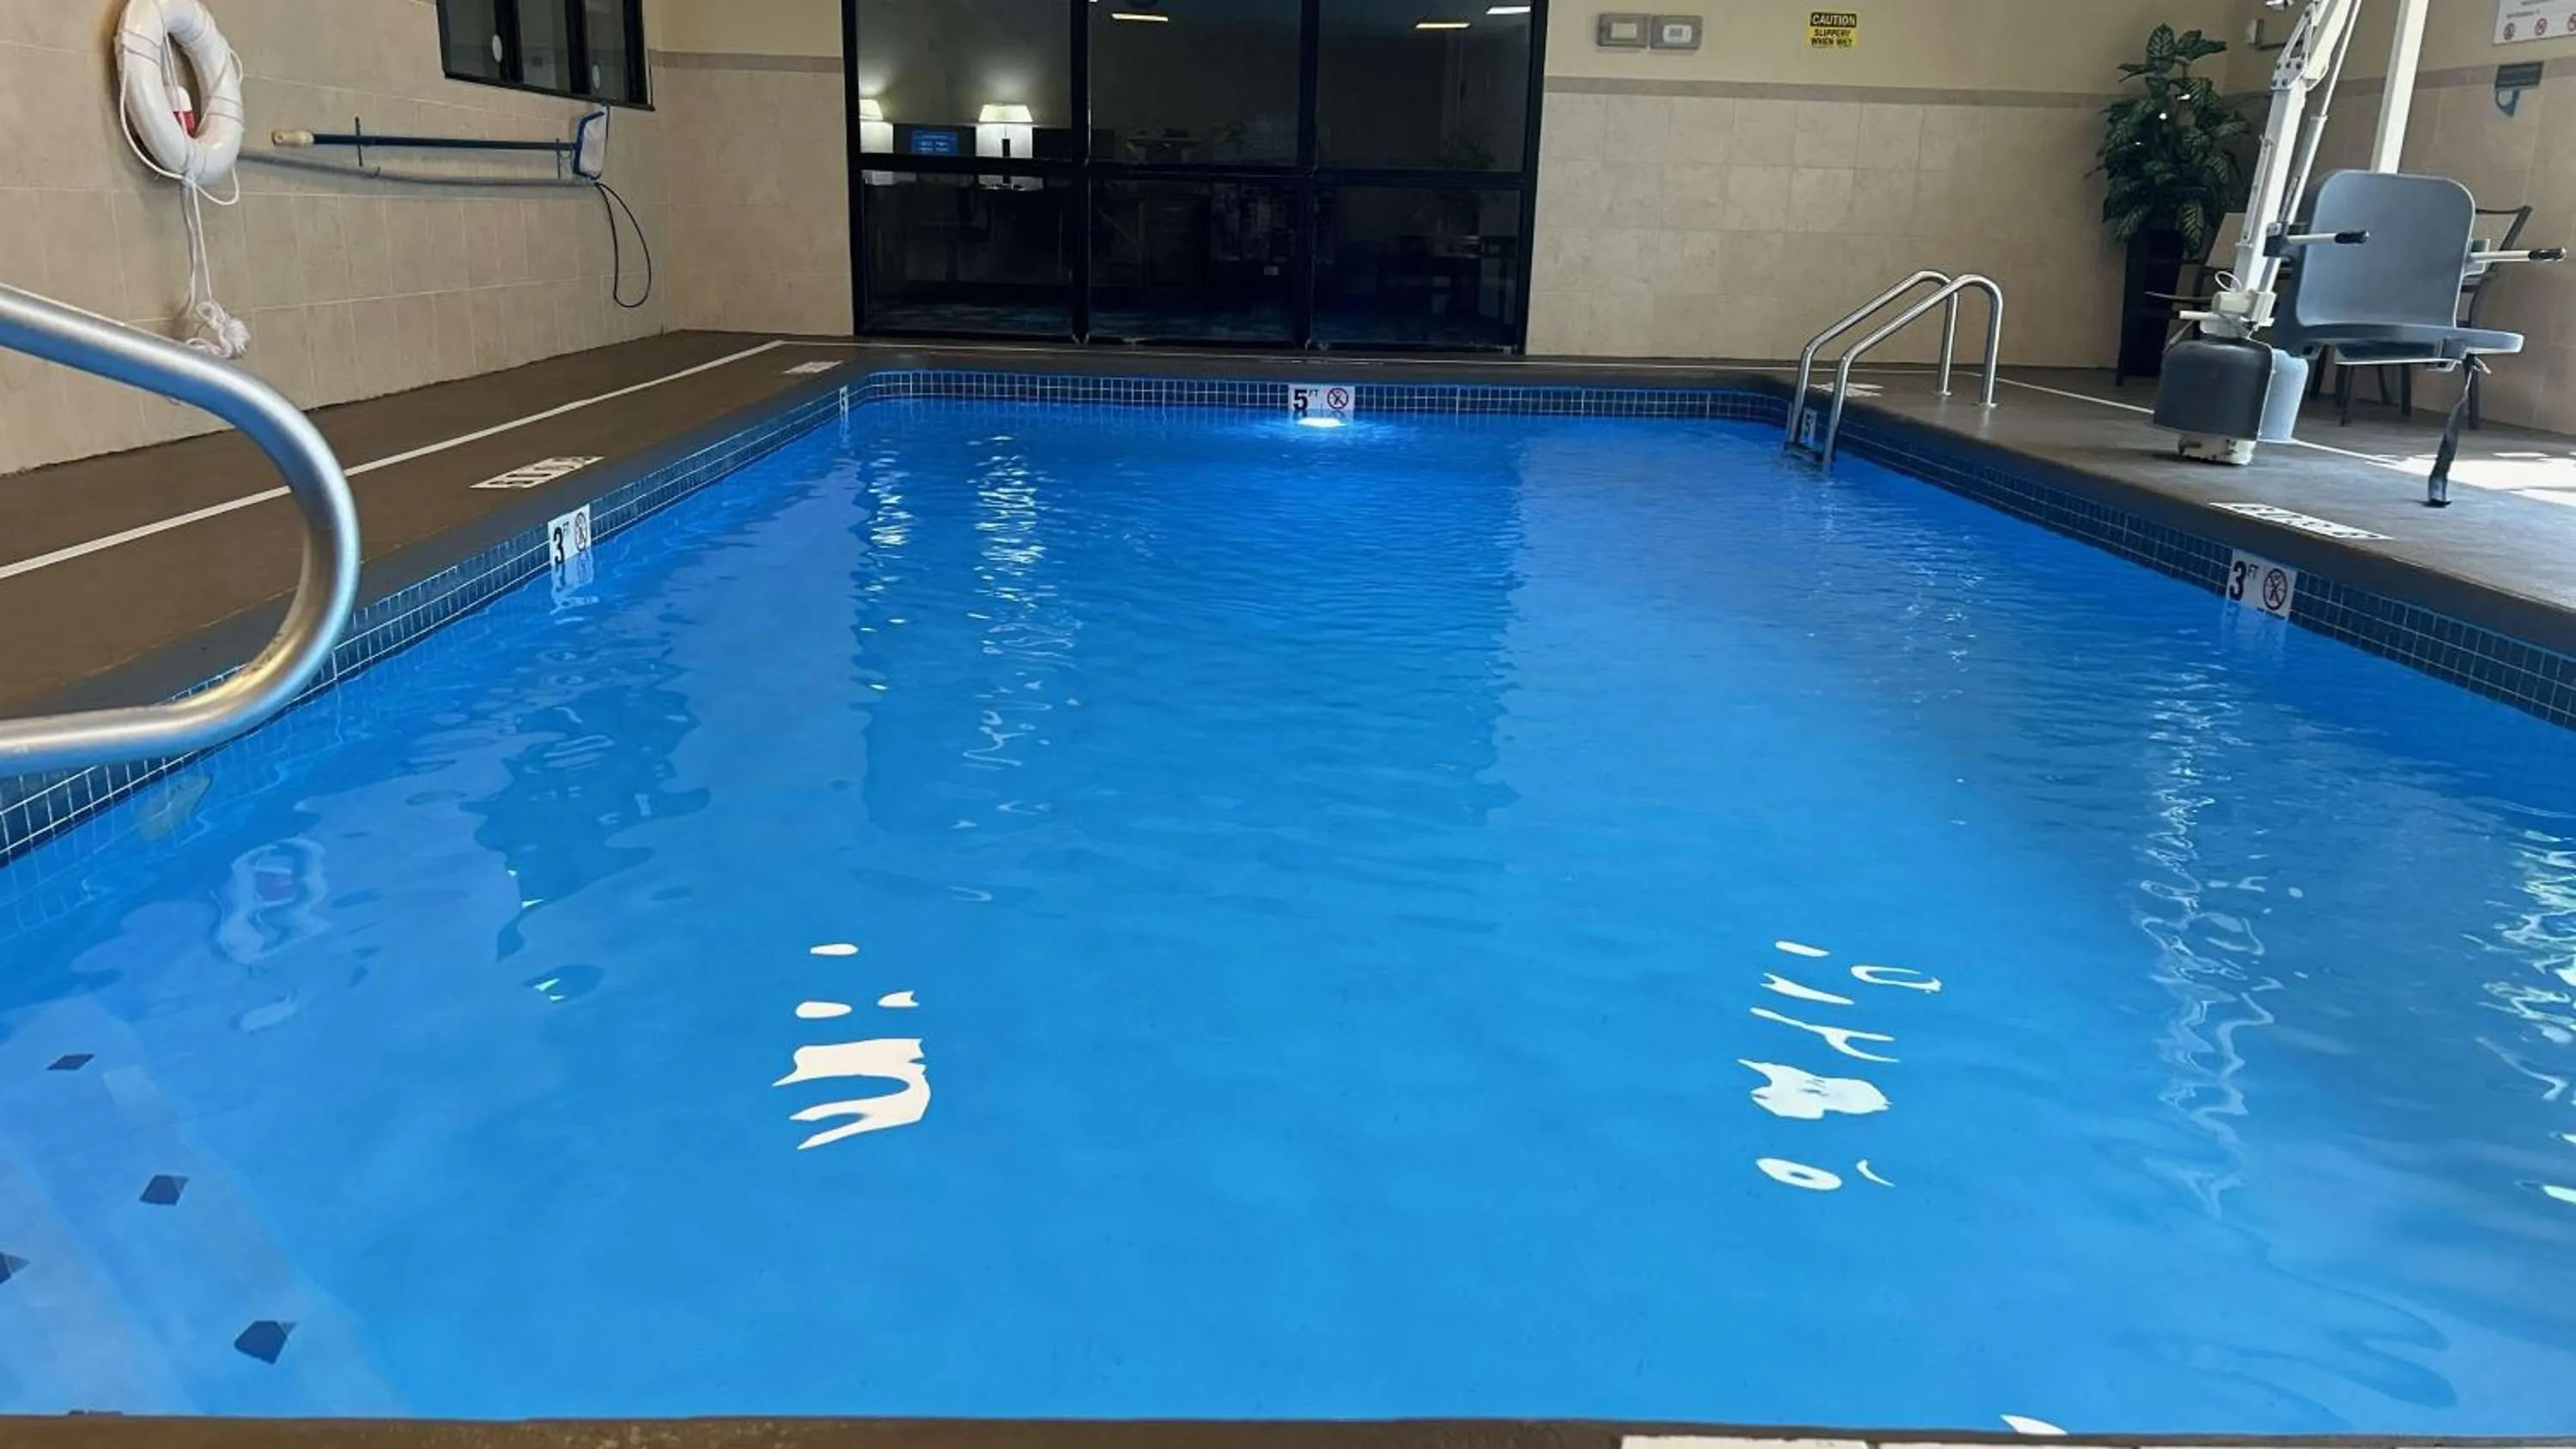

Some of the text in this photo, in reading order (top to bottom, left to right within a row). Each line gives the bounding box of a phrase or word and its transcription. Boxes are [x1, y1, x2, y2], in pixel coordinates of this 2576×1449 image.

[1813, 15, 1856, 26] CAUTION
[1292, 389, 1308, 409] 5
[554, 526, 564, 564] 3
[2229, 560, 2259, 601] 3 FT
